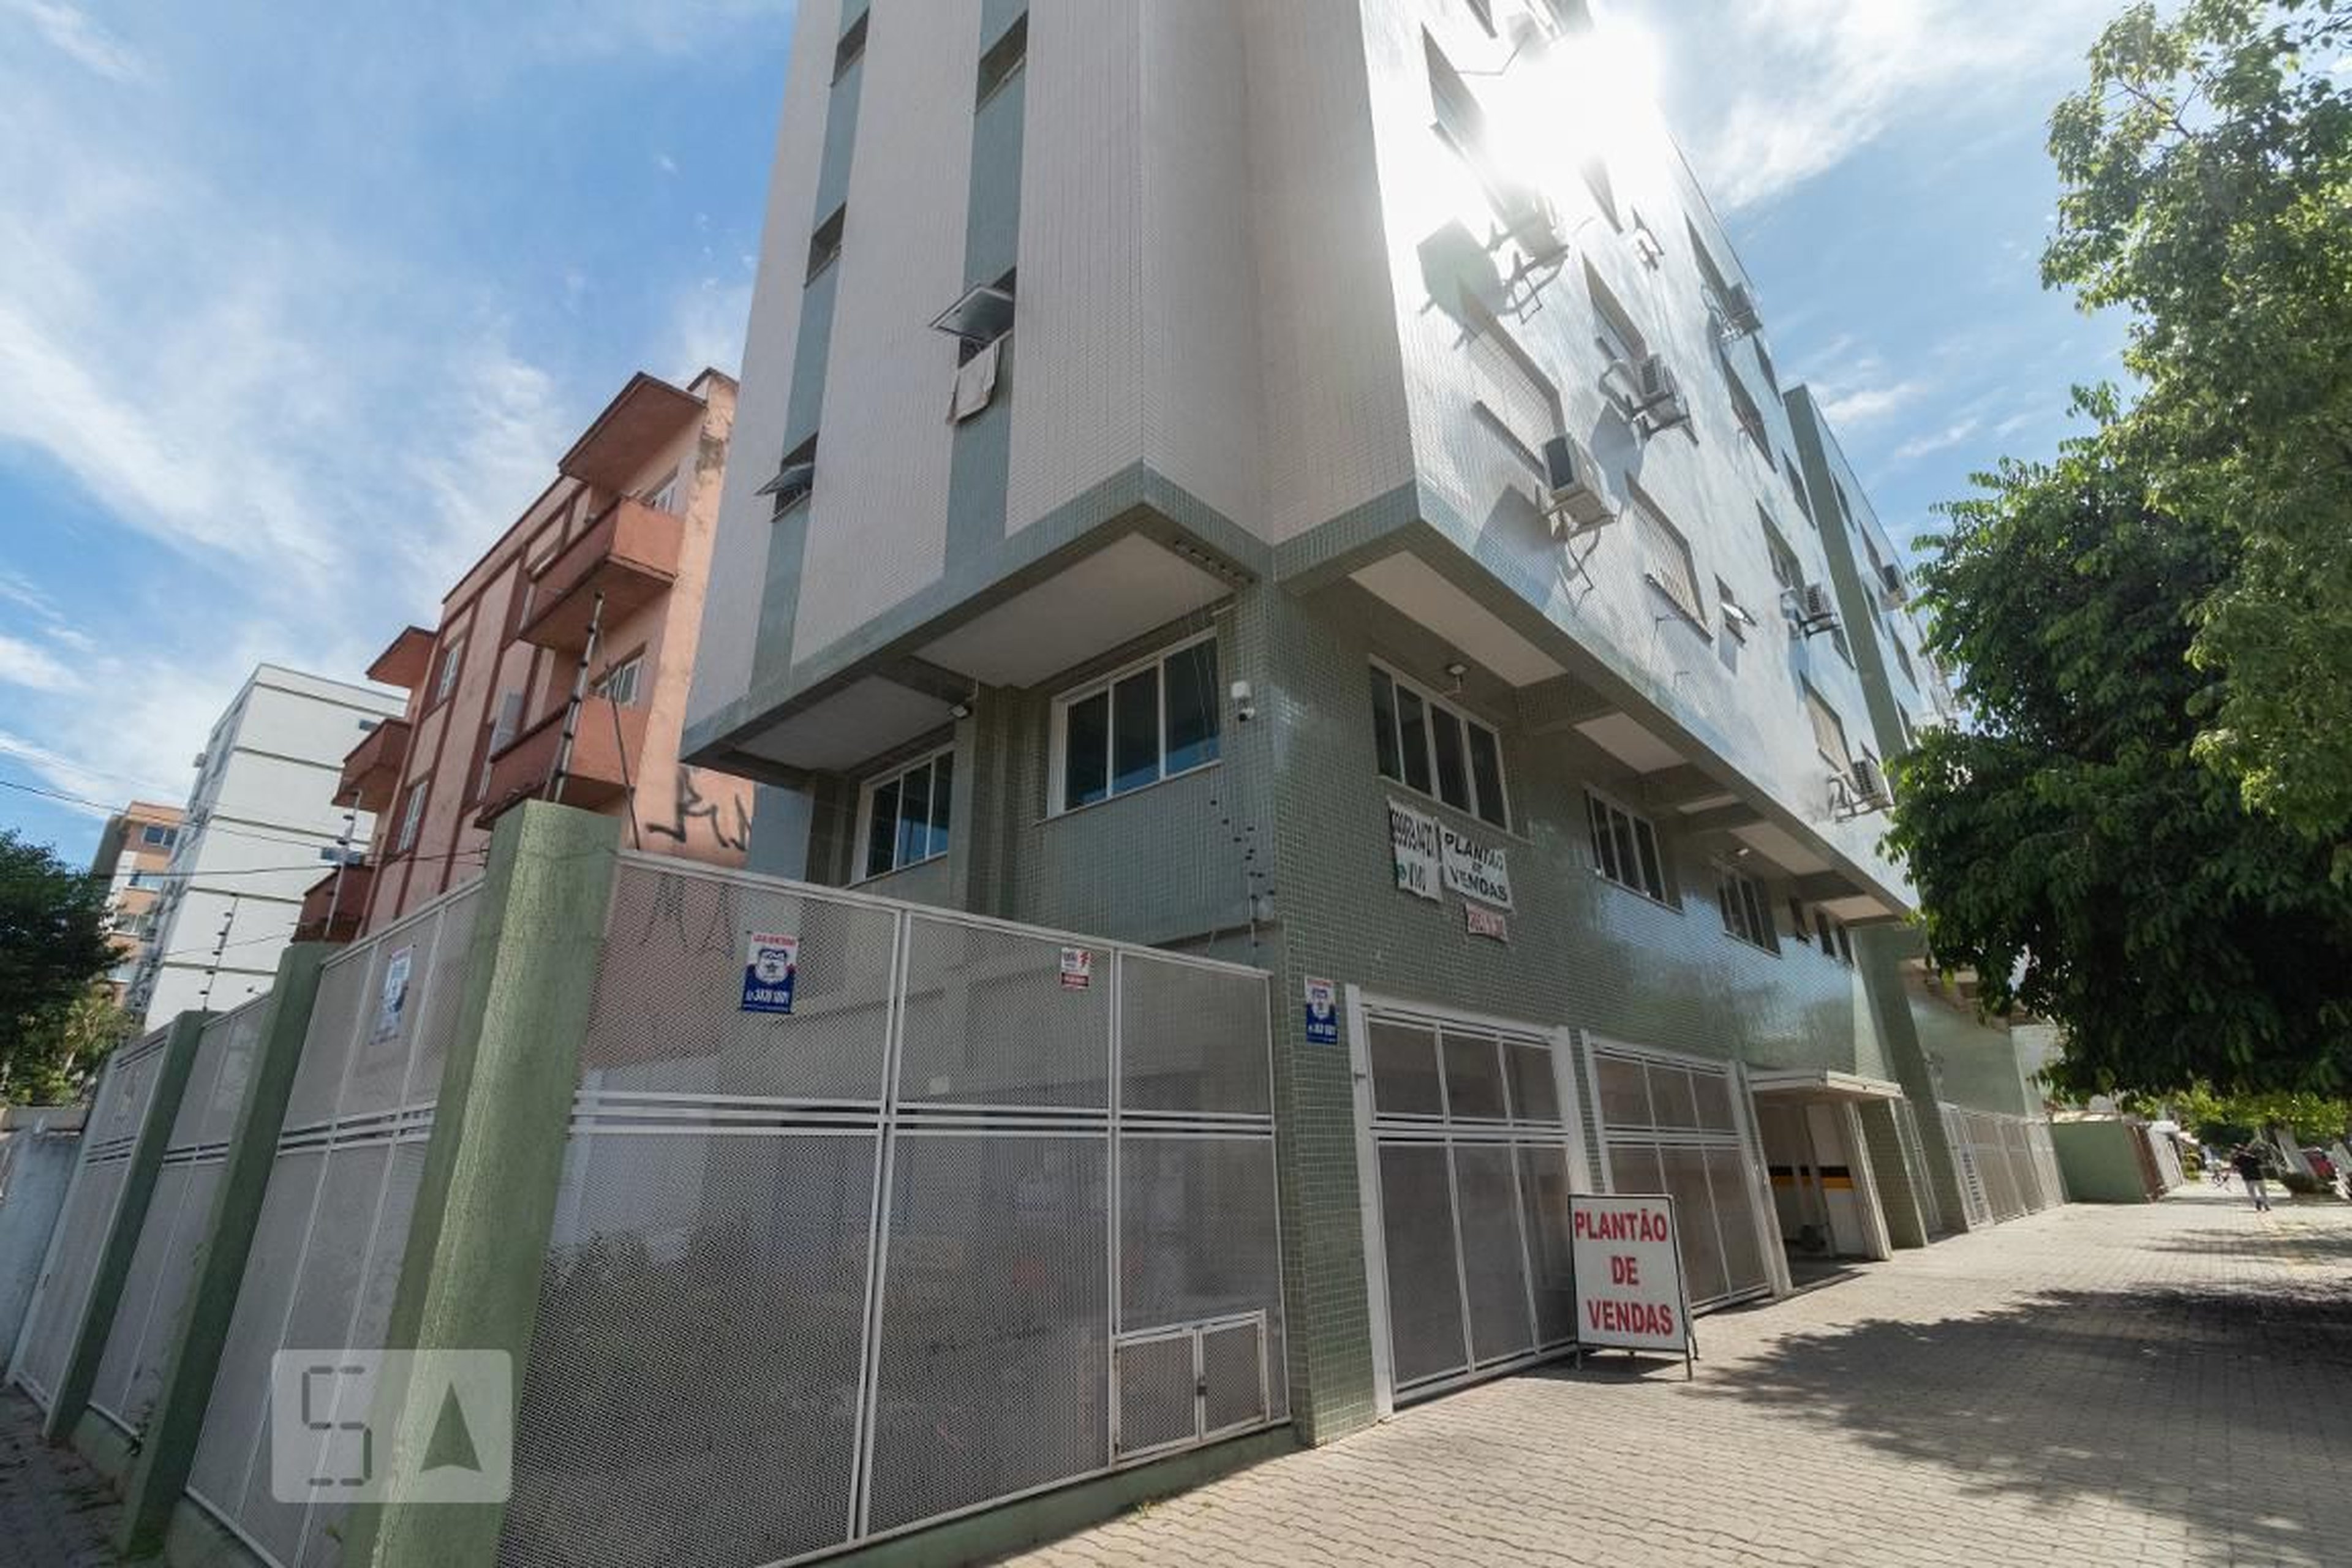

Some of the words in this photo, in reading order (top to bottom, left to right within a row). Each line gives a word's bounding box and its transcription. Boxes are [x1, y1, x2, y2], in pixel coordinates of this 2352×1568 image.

[1449, 865, 1507, 901] VENDAS
[1574, 1208, 1667, 1242] PLANTÃO
[1611, 1256, 1640, 1286] DE
[1587, 1300, 1673, 1335] VENDAS
